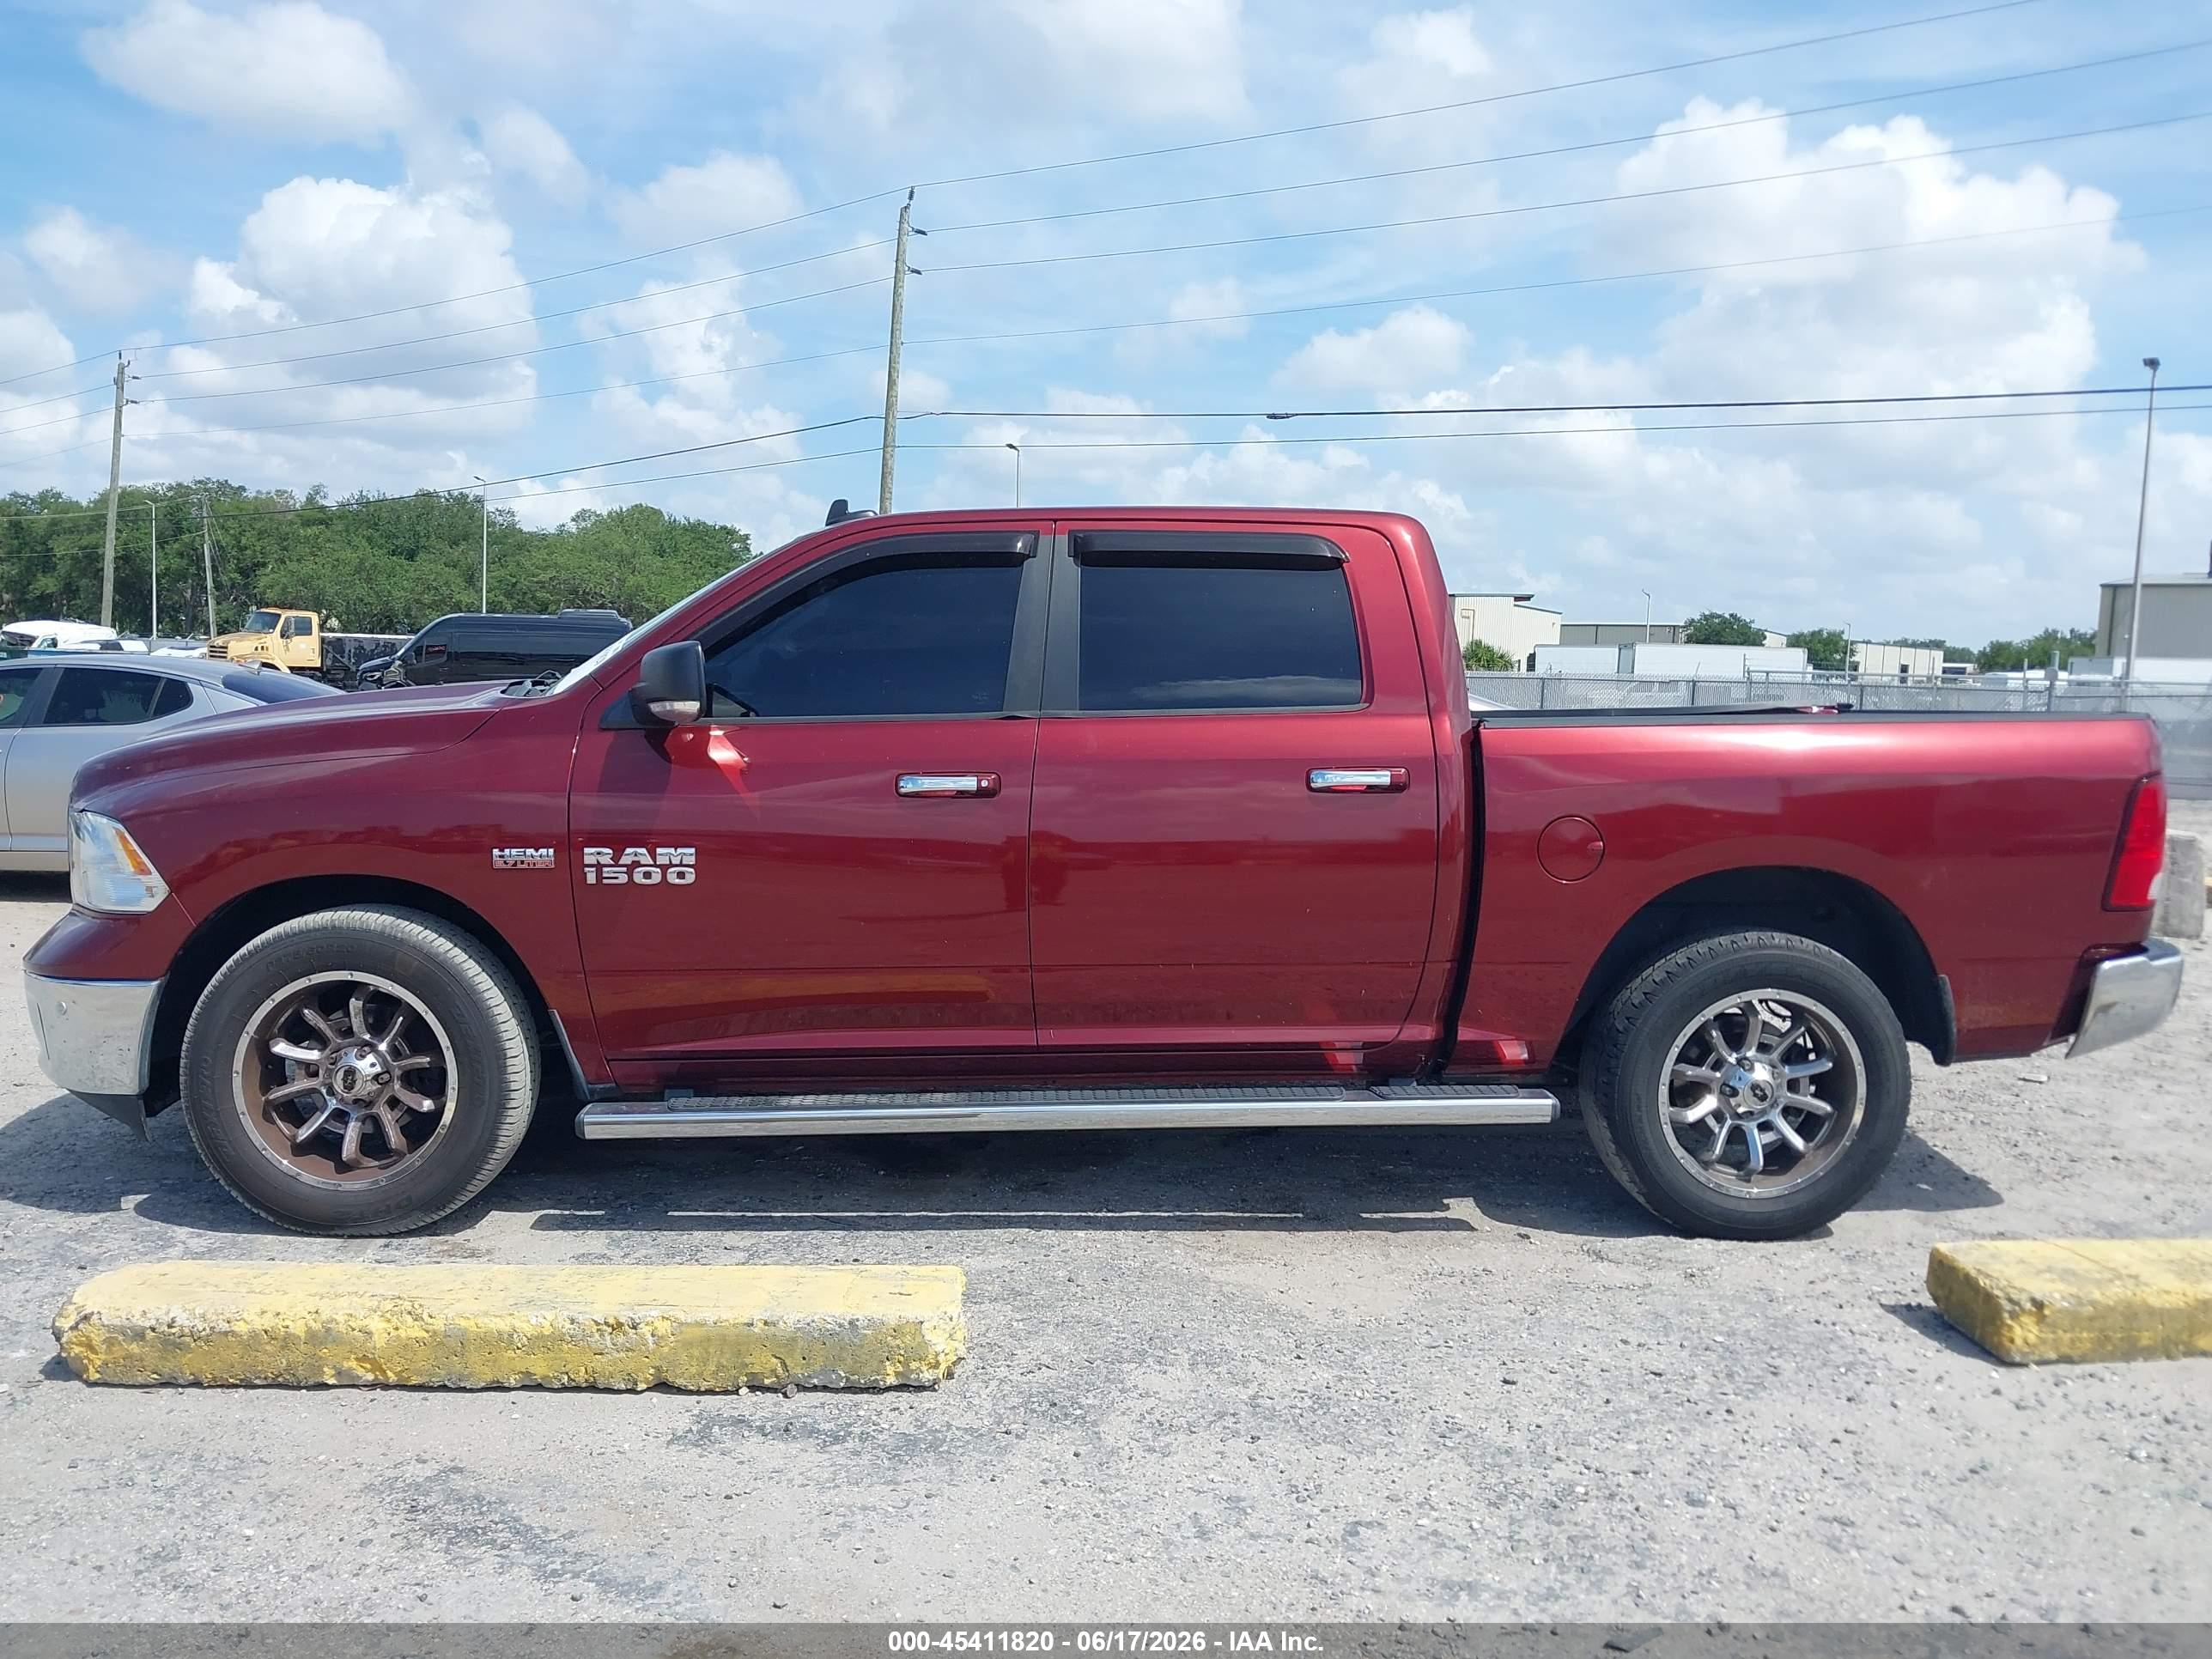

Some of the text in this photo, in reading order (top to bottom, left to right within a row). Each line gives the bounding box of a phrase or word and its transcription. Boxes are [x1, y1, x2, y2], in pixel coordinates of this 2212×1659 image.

[492, 848, 554, 860] HEMI
[583, 847, 696, 865] RAM
[584, 866, 696, 884] 1500
